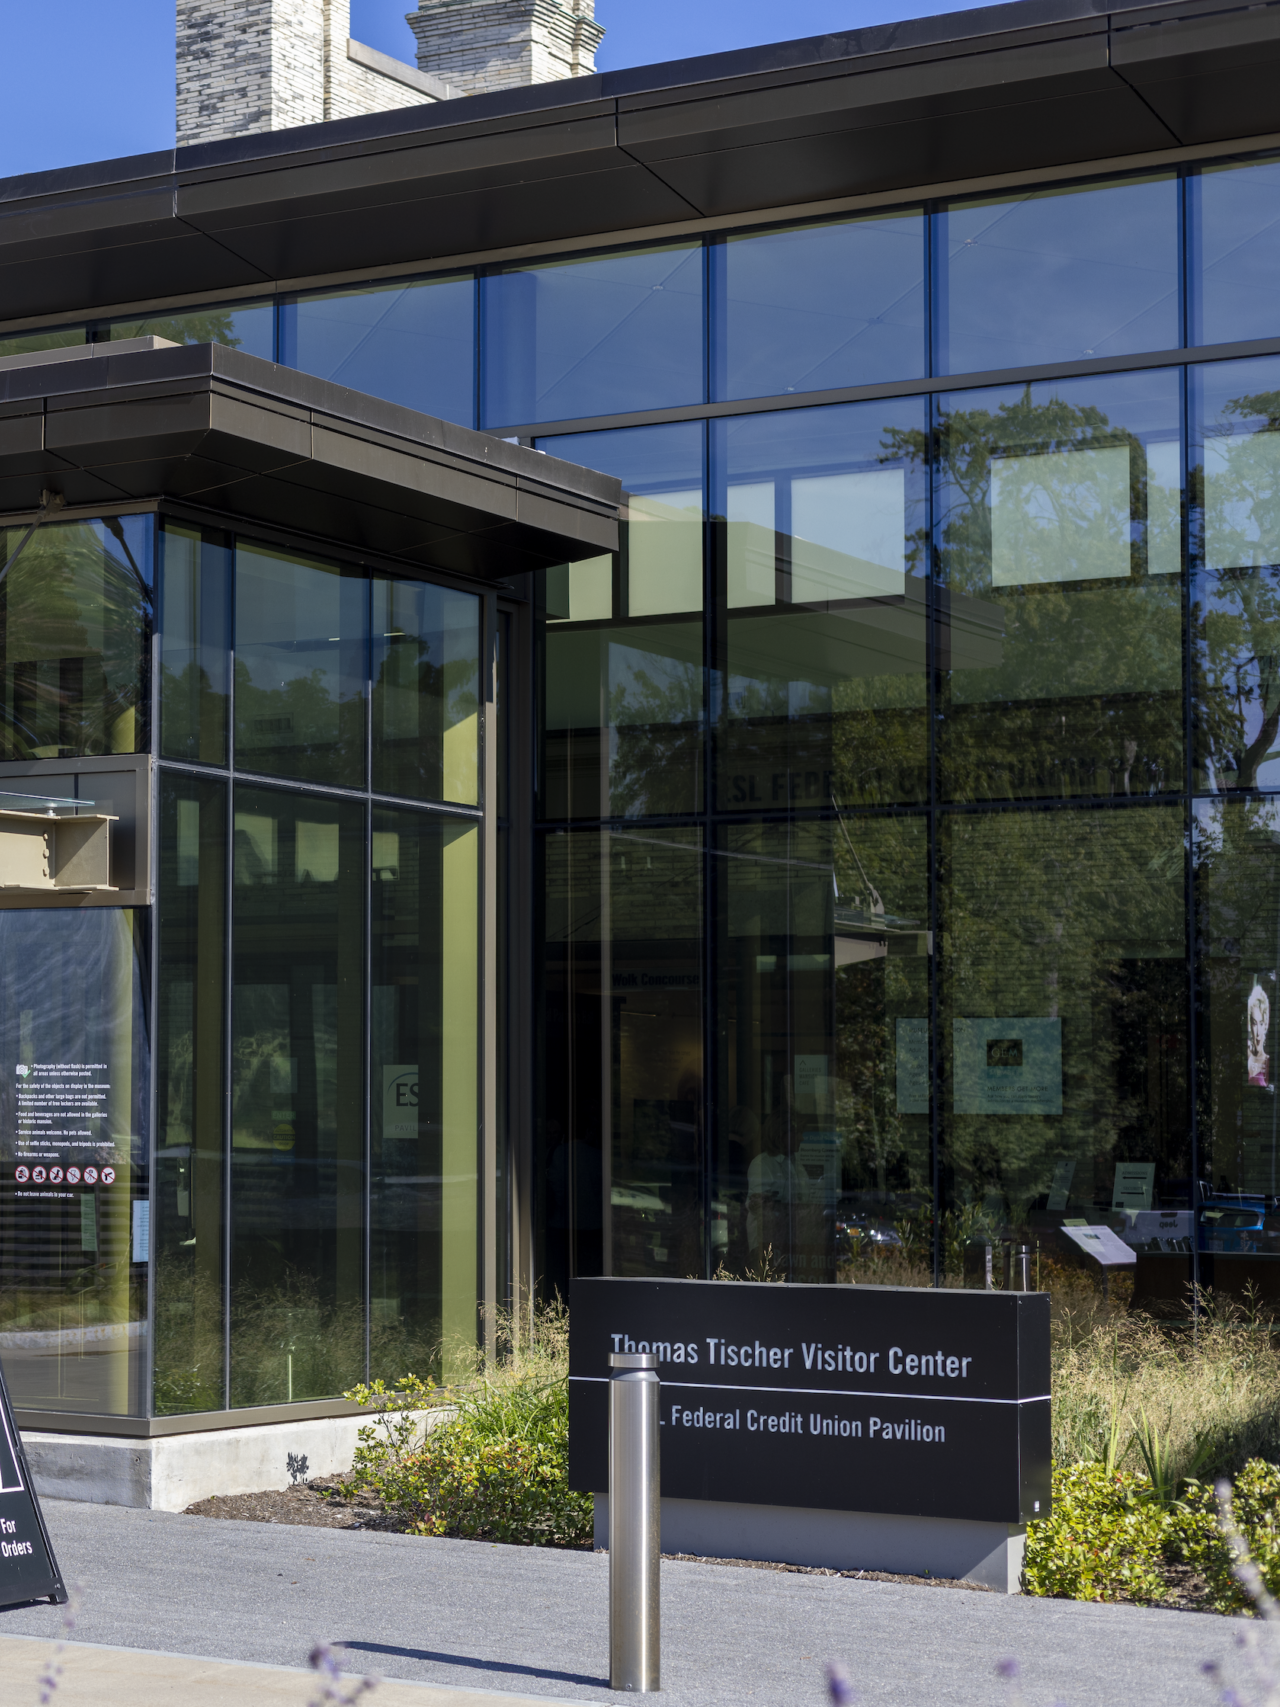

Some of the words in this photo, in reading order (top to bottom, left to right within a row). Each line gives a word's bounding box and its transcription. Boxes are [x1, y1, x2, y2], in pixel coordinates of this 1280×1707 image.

[641, 972, 700, 986] Concourse
[610, 1333, 699, 1365] Thomas
[706, 1338, 794, 1369] Tischer
[801, 1342, 880, 1373] Visitor
[888, 1346, 972, 1378] Center
[671, 1405, 740, 1430] Federal
[747, 1410, 803, 1434] Credit
[810, 1414, 862, 1438] Union
[869, 1417, 946, 1443] Pavilion
[0, 1518, 16, 1534] For
[1, 1540, 32, 1557] Orders
